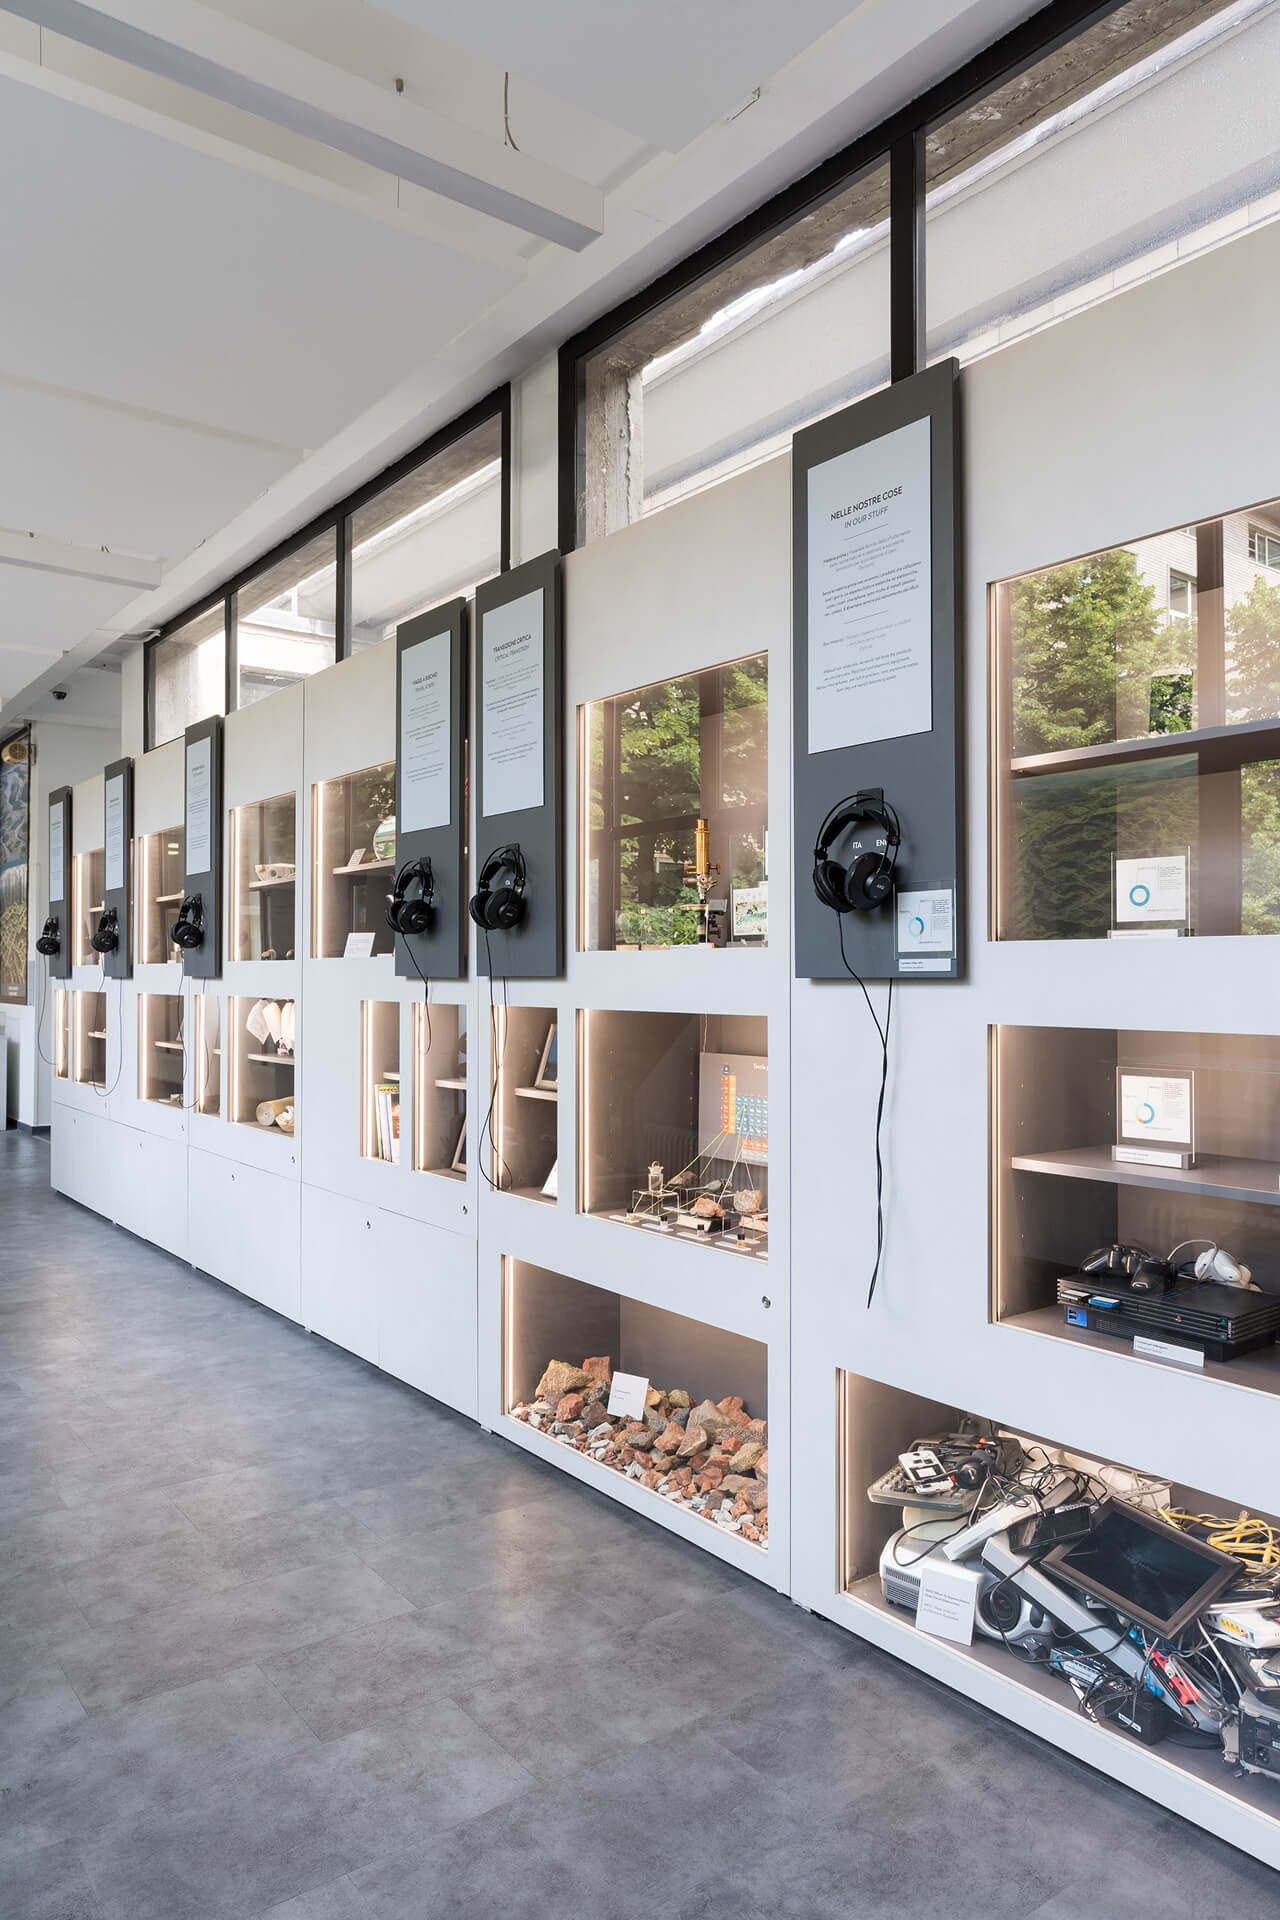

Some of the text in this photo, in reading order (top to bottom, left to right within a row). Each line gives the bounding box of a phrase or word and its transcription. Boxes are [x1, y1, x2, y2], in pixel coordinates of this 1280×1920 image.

[830, 485, 903, 521] NELLE NOSTRE COSE
[844, 505, 889, 529] IN OUR STUFF
[516, 633, 532, 644] CRITICA
[852, 841, 863, 849] ITA
